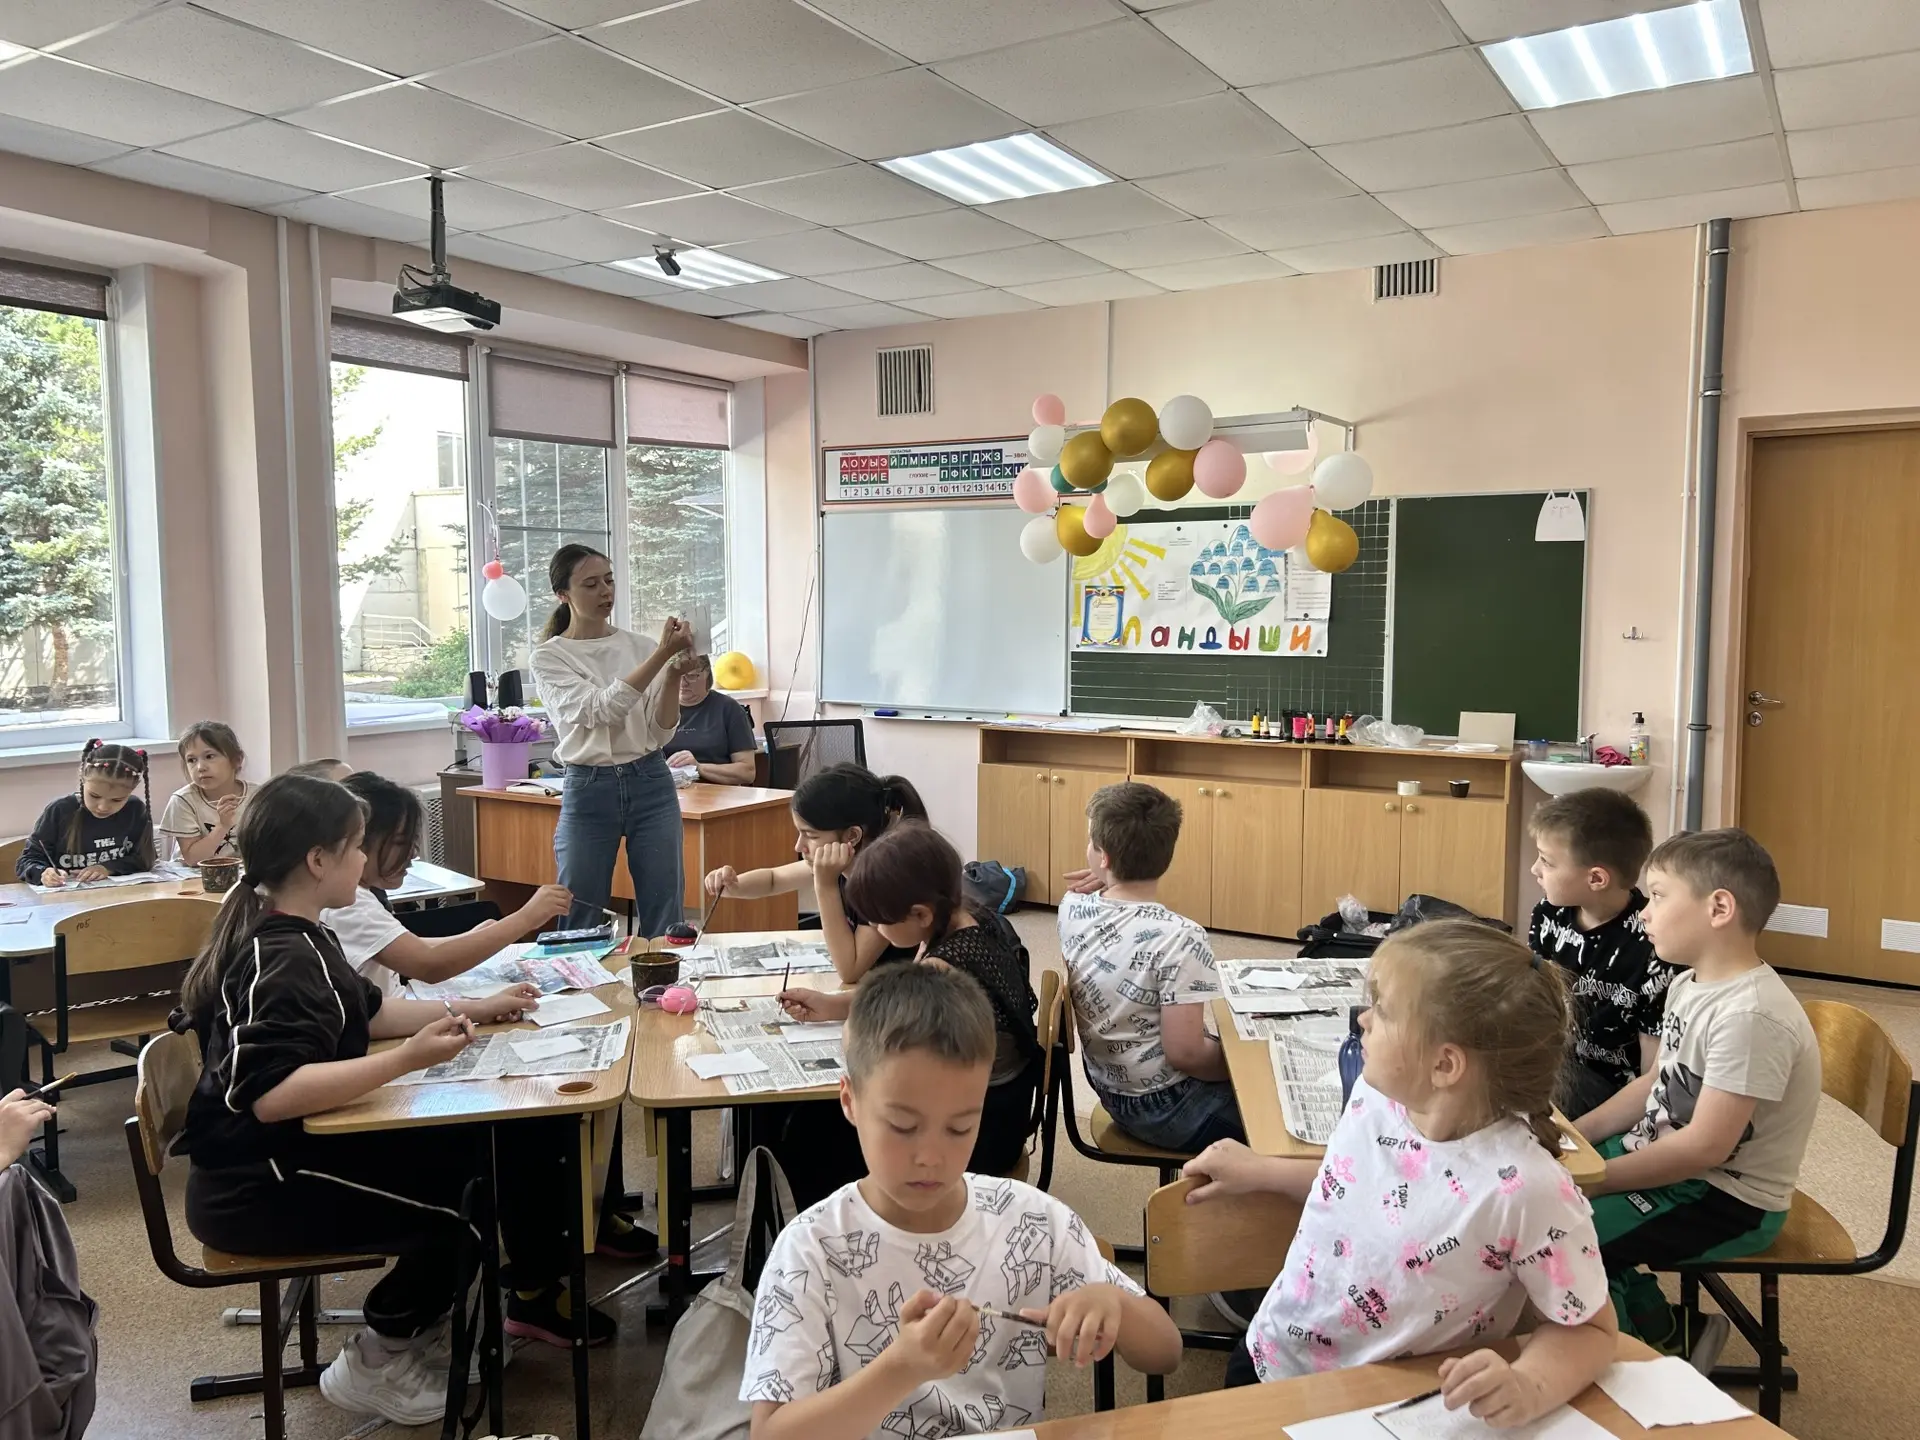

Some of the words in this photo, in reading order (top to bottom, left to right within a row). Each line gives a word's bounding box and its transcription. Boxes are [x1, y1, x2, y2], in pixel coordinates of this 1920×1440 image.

[940, 485, 949, 493] 10
[963, 484, 972, 492] 12
[973, 484, 983, 492] 13
[986, 483, 995, 491] 14
[997, 483, 1007, 491] 15
[1376, 1135, 1399, 1148] KEEP
[1399, 1139, 1406, 1150] IT
[1436, 1235, 1461, 1257] KEEP
[1425, 1248, 1435, 1263] IT
[1287, 1323, 1304, 1338] KEEP
[1304, 1331, 1313, 1342] IT
